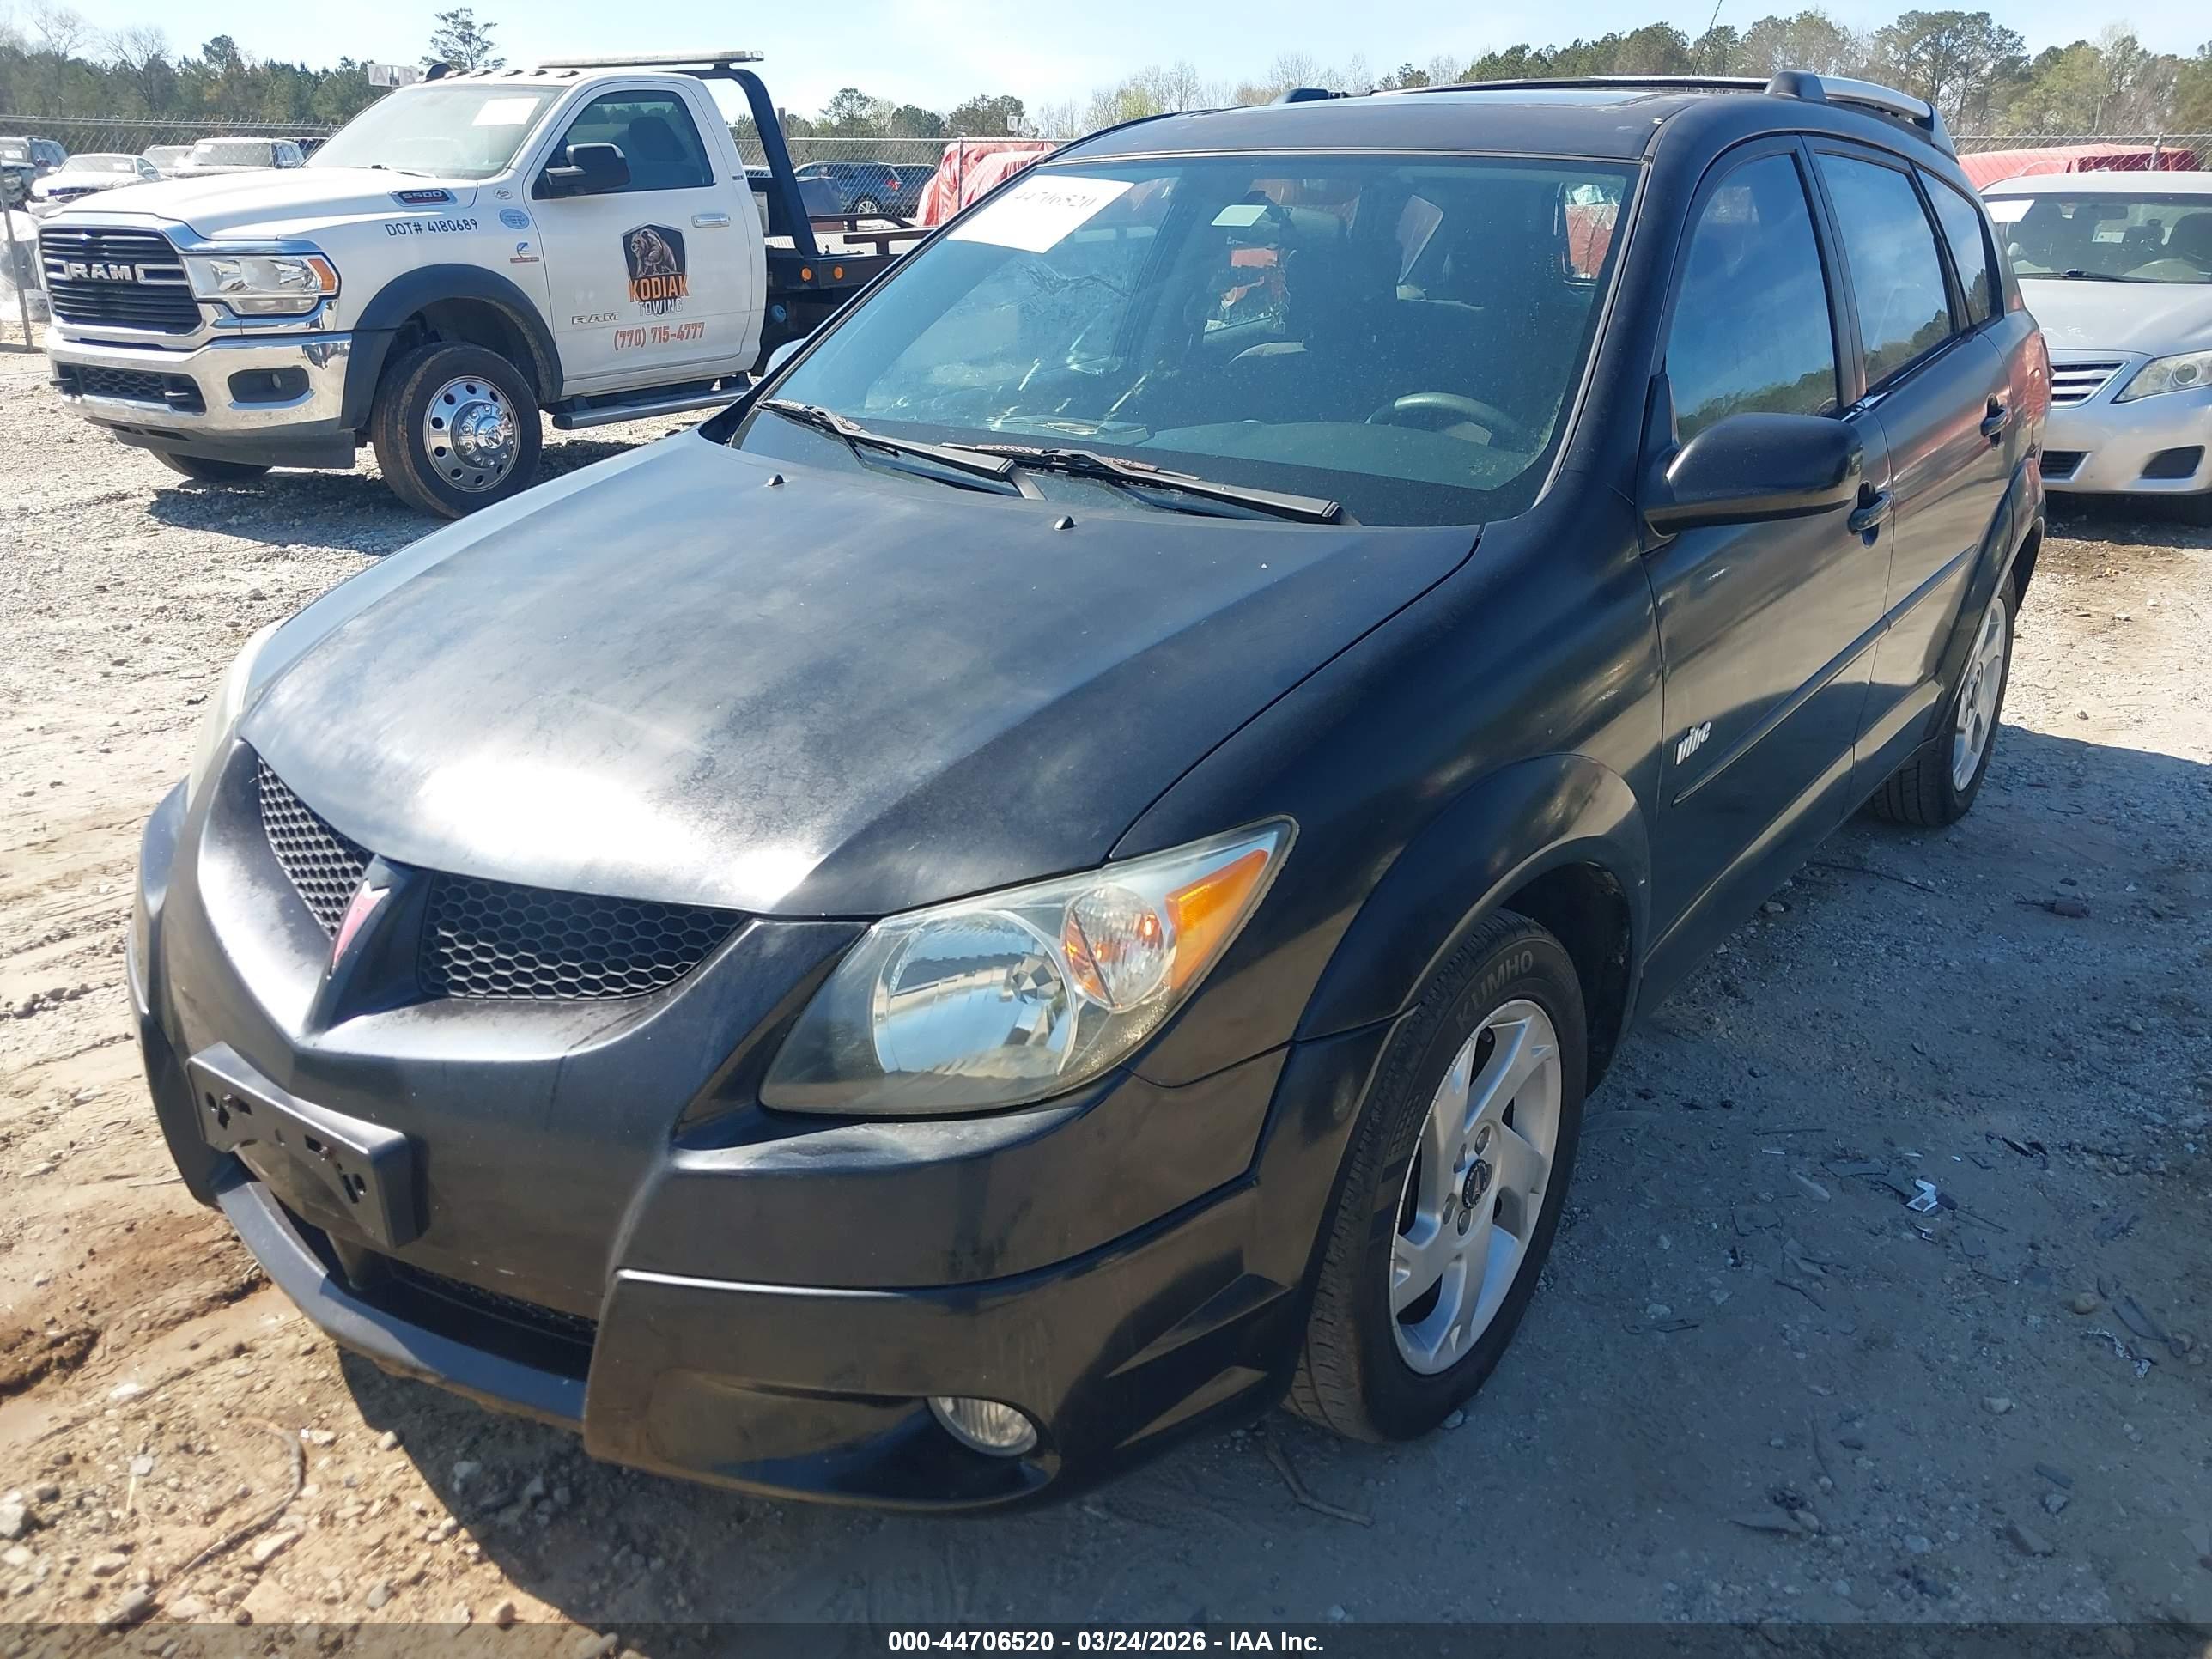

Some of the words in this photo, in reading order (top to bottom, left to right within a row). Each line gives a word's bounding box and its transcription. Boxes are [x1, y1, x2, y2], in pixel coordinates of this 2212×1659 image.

[372, 66, 387, 83] A
[402, 68, 416, 84] B
[402, 191, 443, 200] 5500
[385, 222, 423, 236] DOT#
[428, 218, 478, 234] 4180689
[69, 262, 133, 281] RAM
[629, 275, 691, 303] KODIAK
[638, 297, 684, 317] TOWING
[571, 312, 619, 325] RAM
[613, 326, 647, 351] (770)
[650, 321, 706, 344] 715-4777
[1455, 950, 1534, 1030] KUMHO
